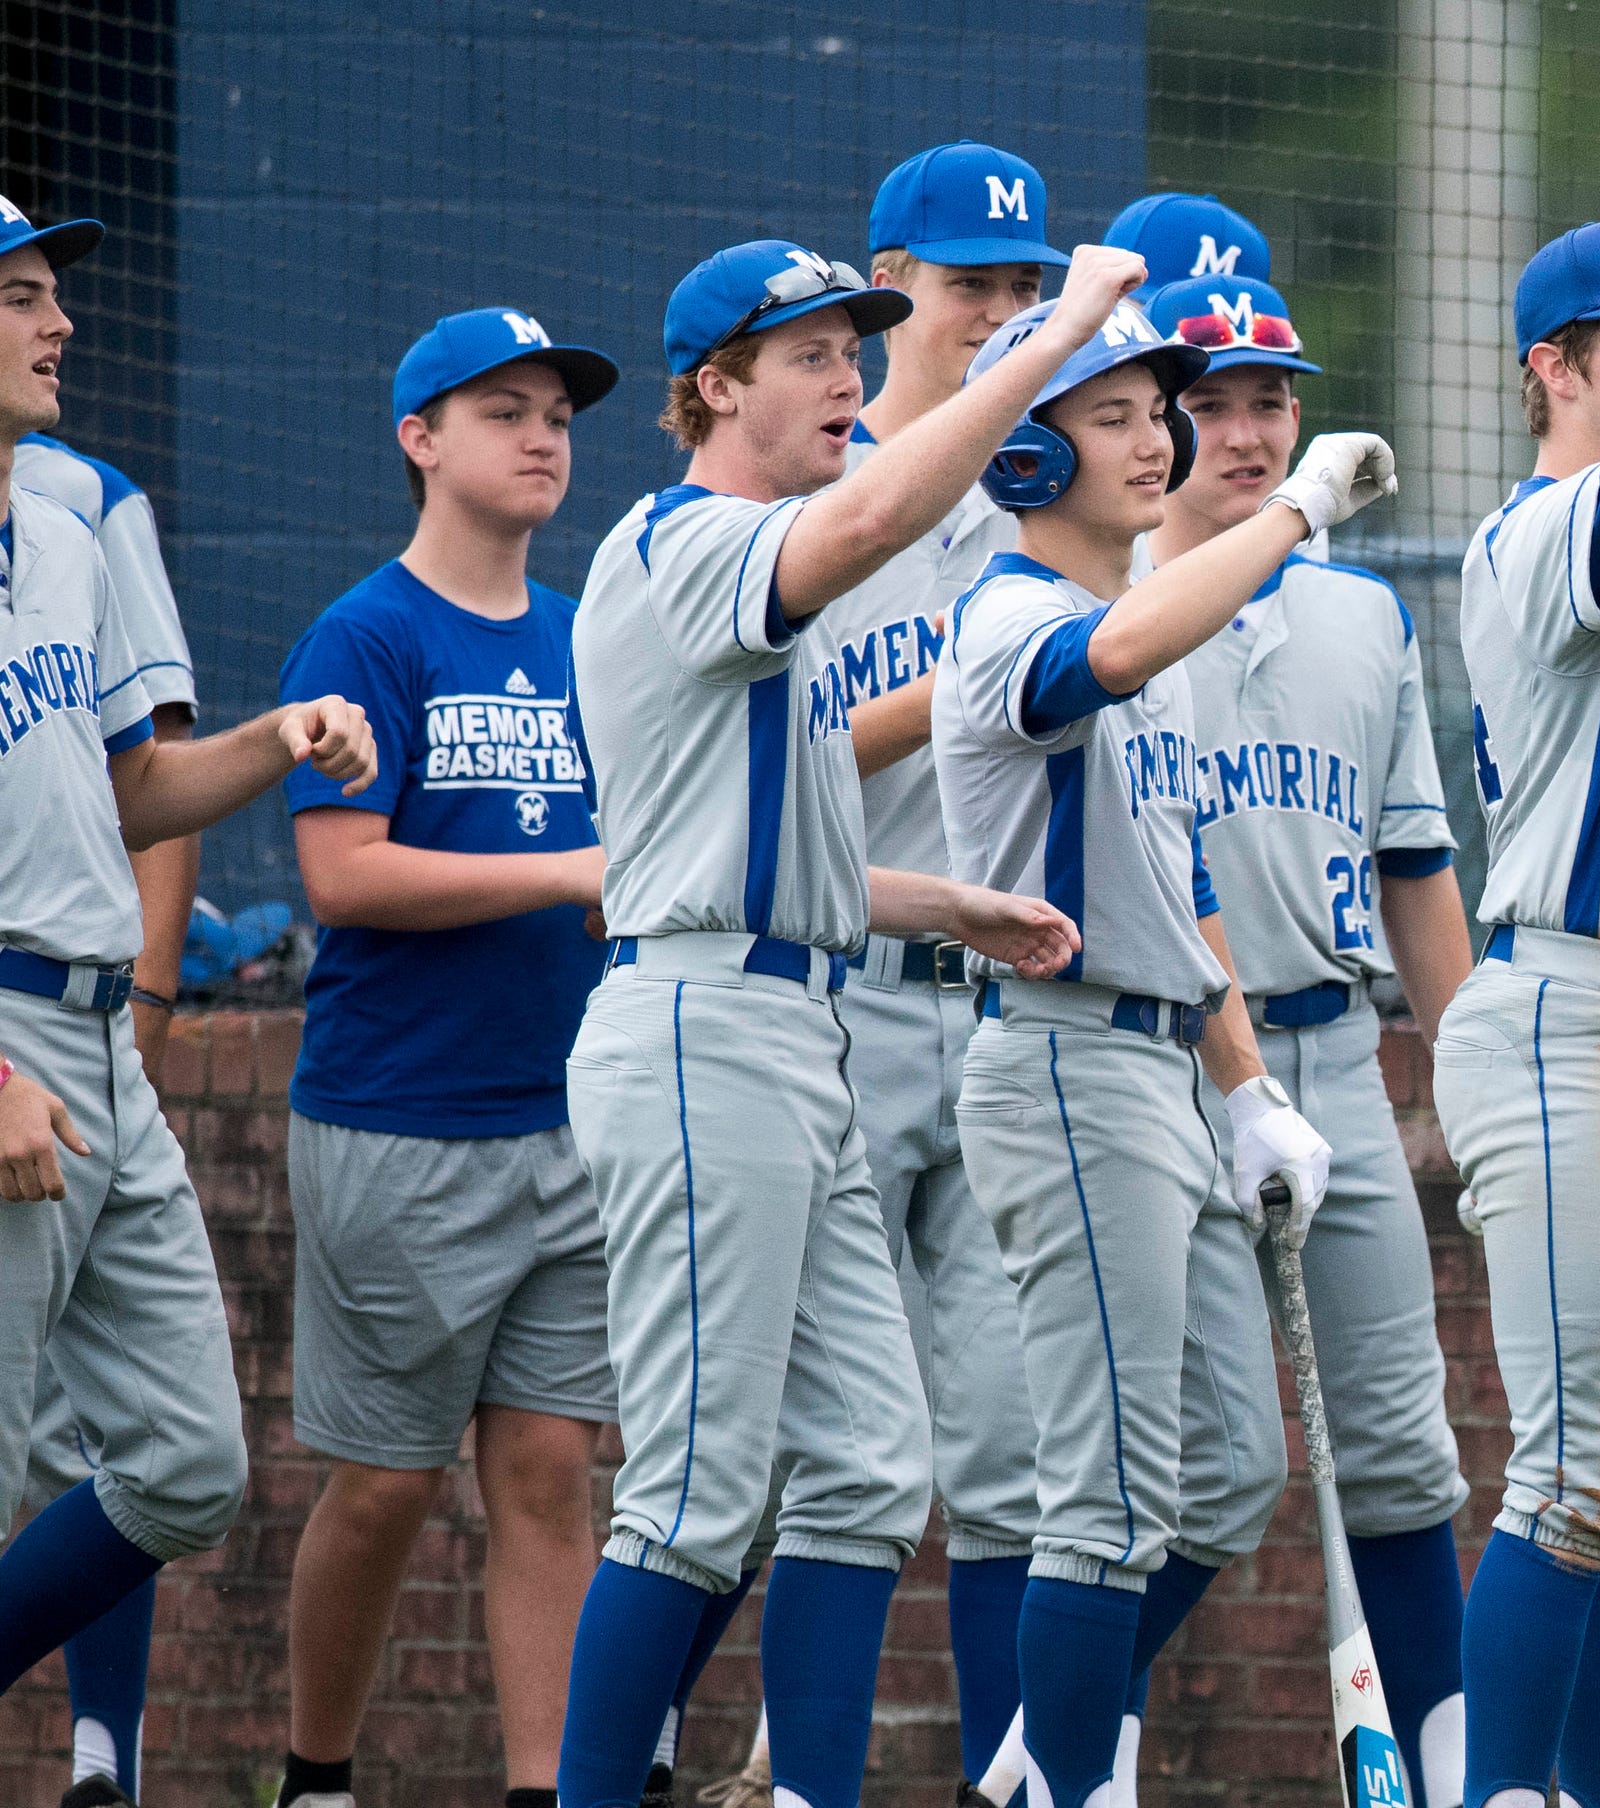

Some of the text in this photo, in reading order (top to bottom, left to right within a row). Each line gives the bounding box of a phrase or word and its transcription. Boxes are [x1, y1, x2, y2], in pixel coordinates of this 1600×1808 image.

[985, 175, 1029, 221] M
[1189, 234, 1242, 277] M
[502, 312, 553, 348] M
[1101, 305, 1154, 348] M
[427, 704, 571, 748] MEMOR
[1332, 1536, 1350, 1589] LOUISVILLE
